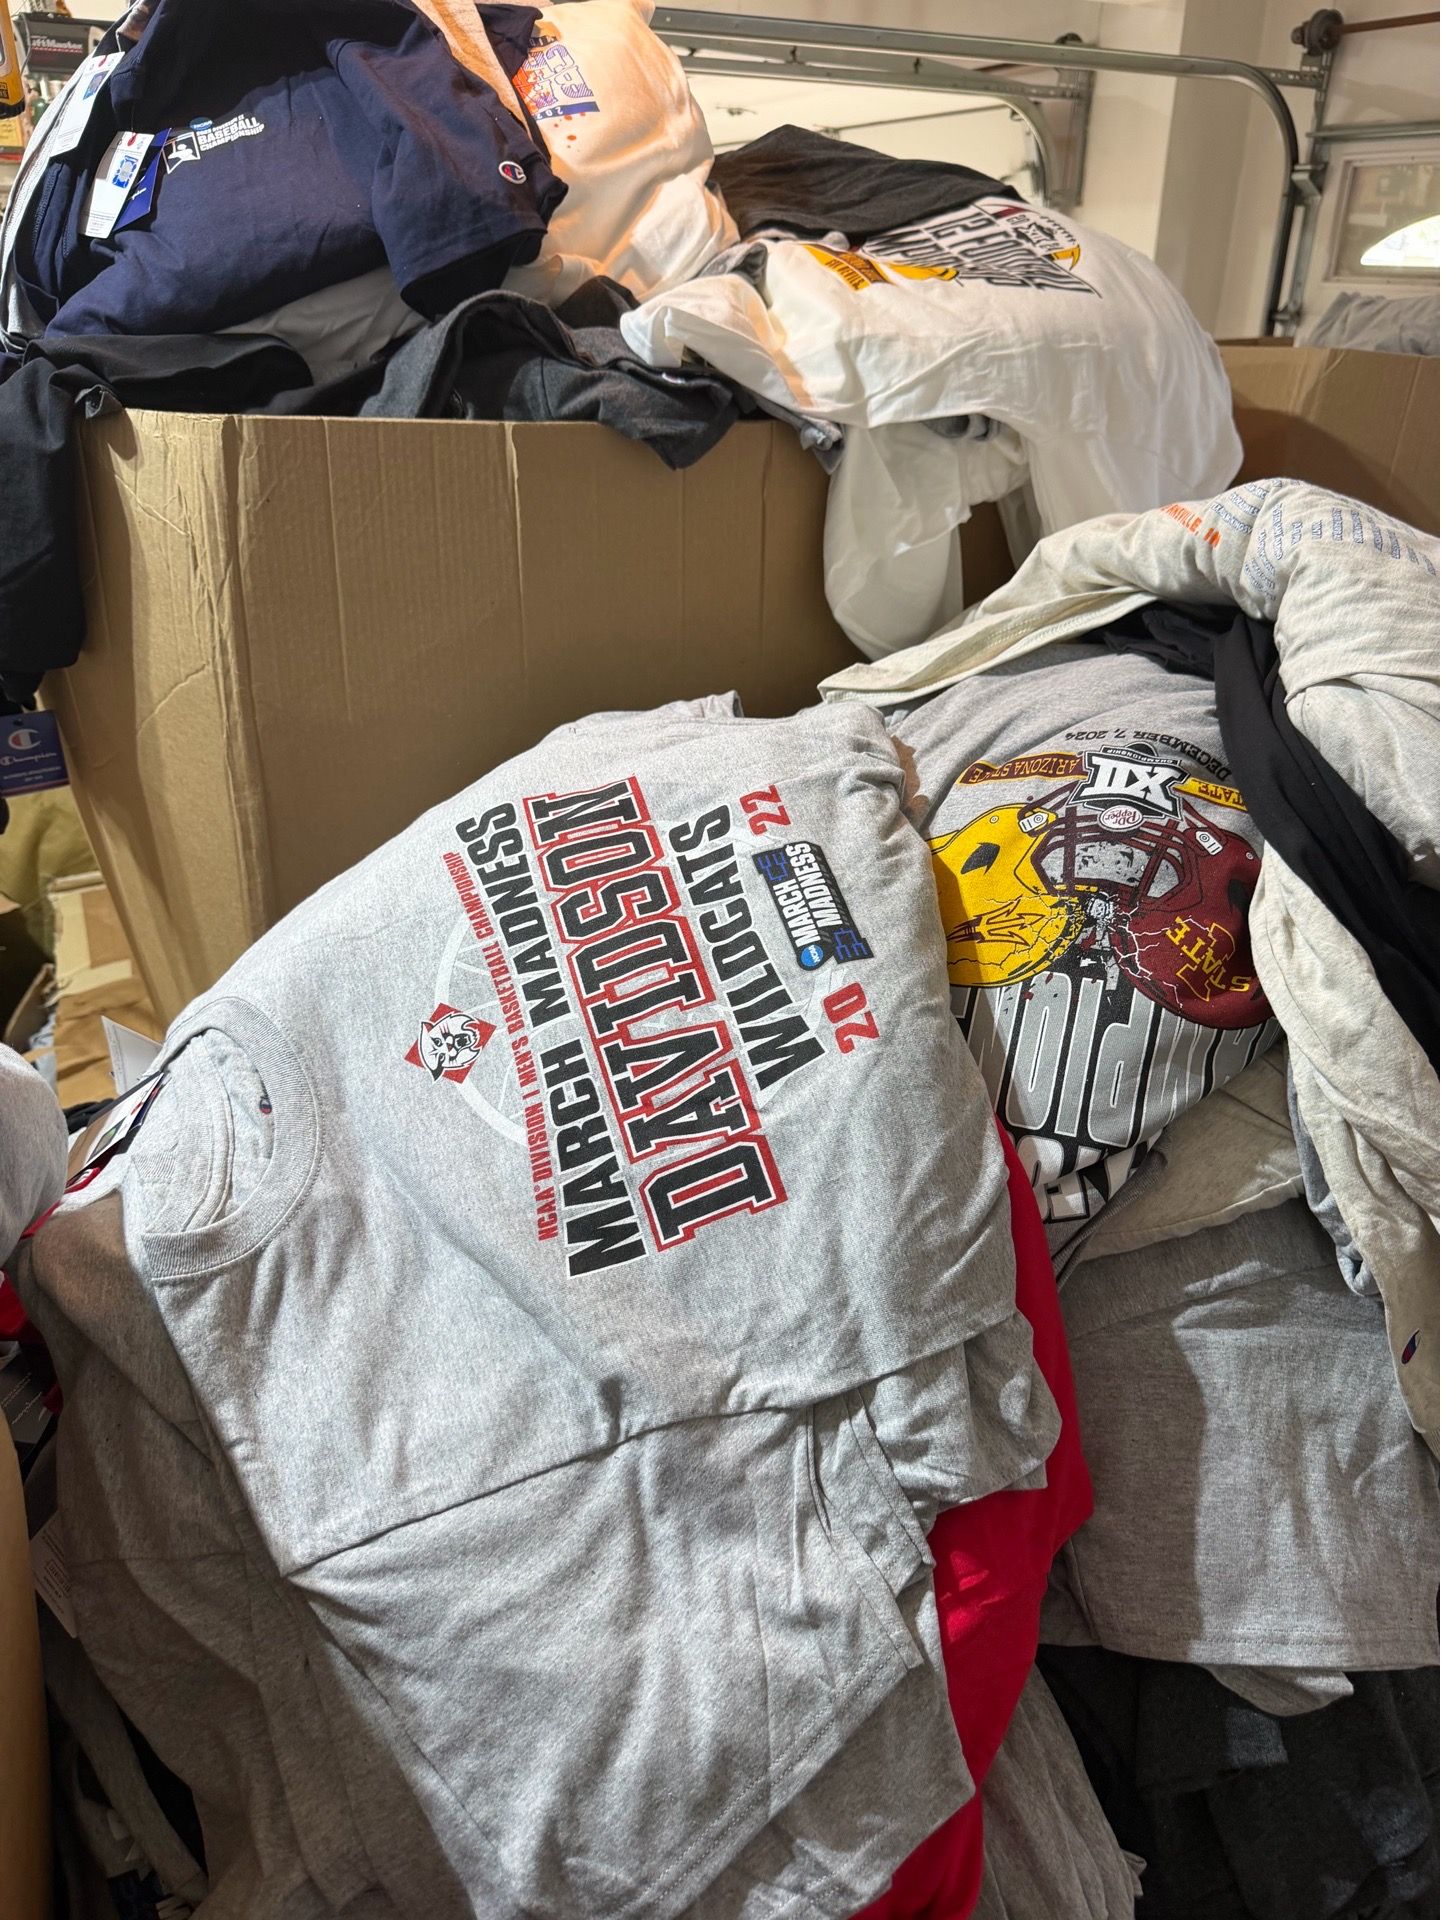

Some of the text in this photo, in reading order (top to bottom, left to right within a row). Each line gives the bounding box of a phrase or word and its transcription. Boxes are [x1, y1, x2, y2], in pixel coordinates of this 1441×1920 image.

[197, 117, 260, 145] BASEBALL
[199, 123, 265, 152] CHAMPIONSHIP
[1013, 757, 1081, 776] ARIZONA
[1064, 728, 1233, 782] DECEMBER 7, 2024
[1106, 748, 1174, 765] CHAMPIONSHIP
[740, 785, 792, 836] 22
[1079, 756, 1178, 812] XII
[1199, 781, 1244, 807] TATE
[1104, 809, 1137, 825] Pepper
[1113, 816, 1127, 826] Dr
[443, 851, 495, 940] CHAMPIONSHIP
[772, 879, 821, 948] MARCH
[785, 843, 843, 928] MADNESS
[669, 804, 826, 1091] WILDCATS
[1165, 916, 1252, 993] STATE
[482, 940, 525, 1035] BASKETBALL
[522, 775, 789, 1252] DAVIDSON
[456, 802, 648, 1277] MARCH MADNESS
[823, 983, 881, 1055] 20
[511, 1035, 538, 1088] MEN'S
[524, 1102, 553, 1183] DIVISION
